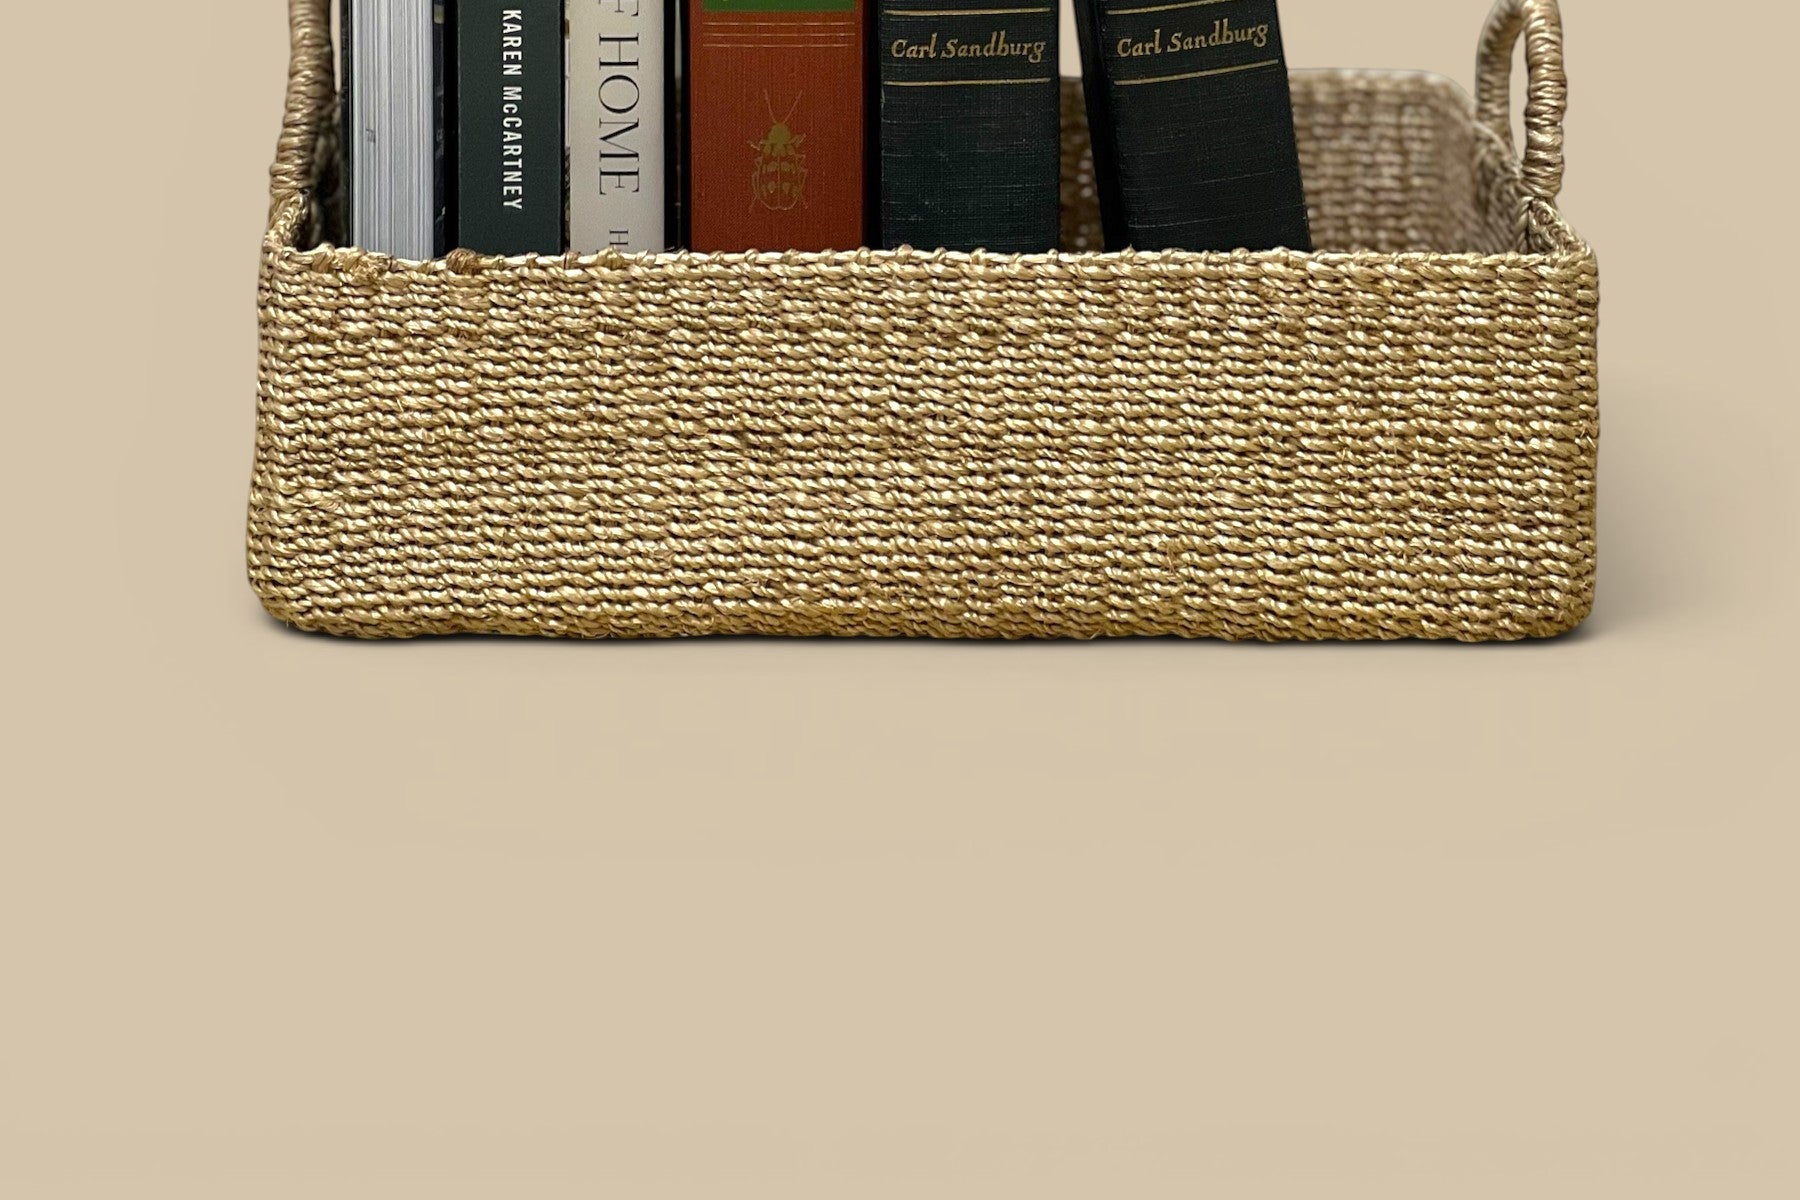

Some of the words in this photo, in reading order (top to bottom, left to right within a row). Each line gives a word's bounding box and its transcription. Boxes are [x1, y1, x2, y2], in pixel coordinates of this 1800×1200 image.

[502, 9, 522, 76] KAREN
[891, 32, 938, 59] Carl
[940, 30, 1046, 63] Sandburg
[1116, 28, 1162, 58] Carl
[1167, 17, 1269, 53] Sandburg
[598, 32, 640, 196] HOME
[503, 86, 522, 210] McCARTNEY
